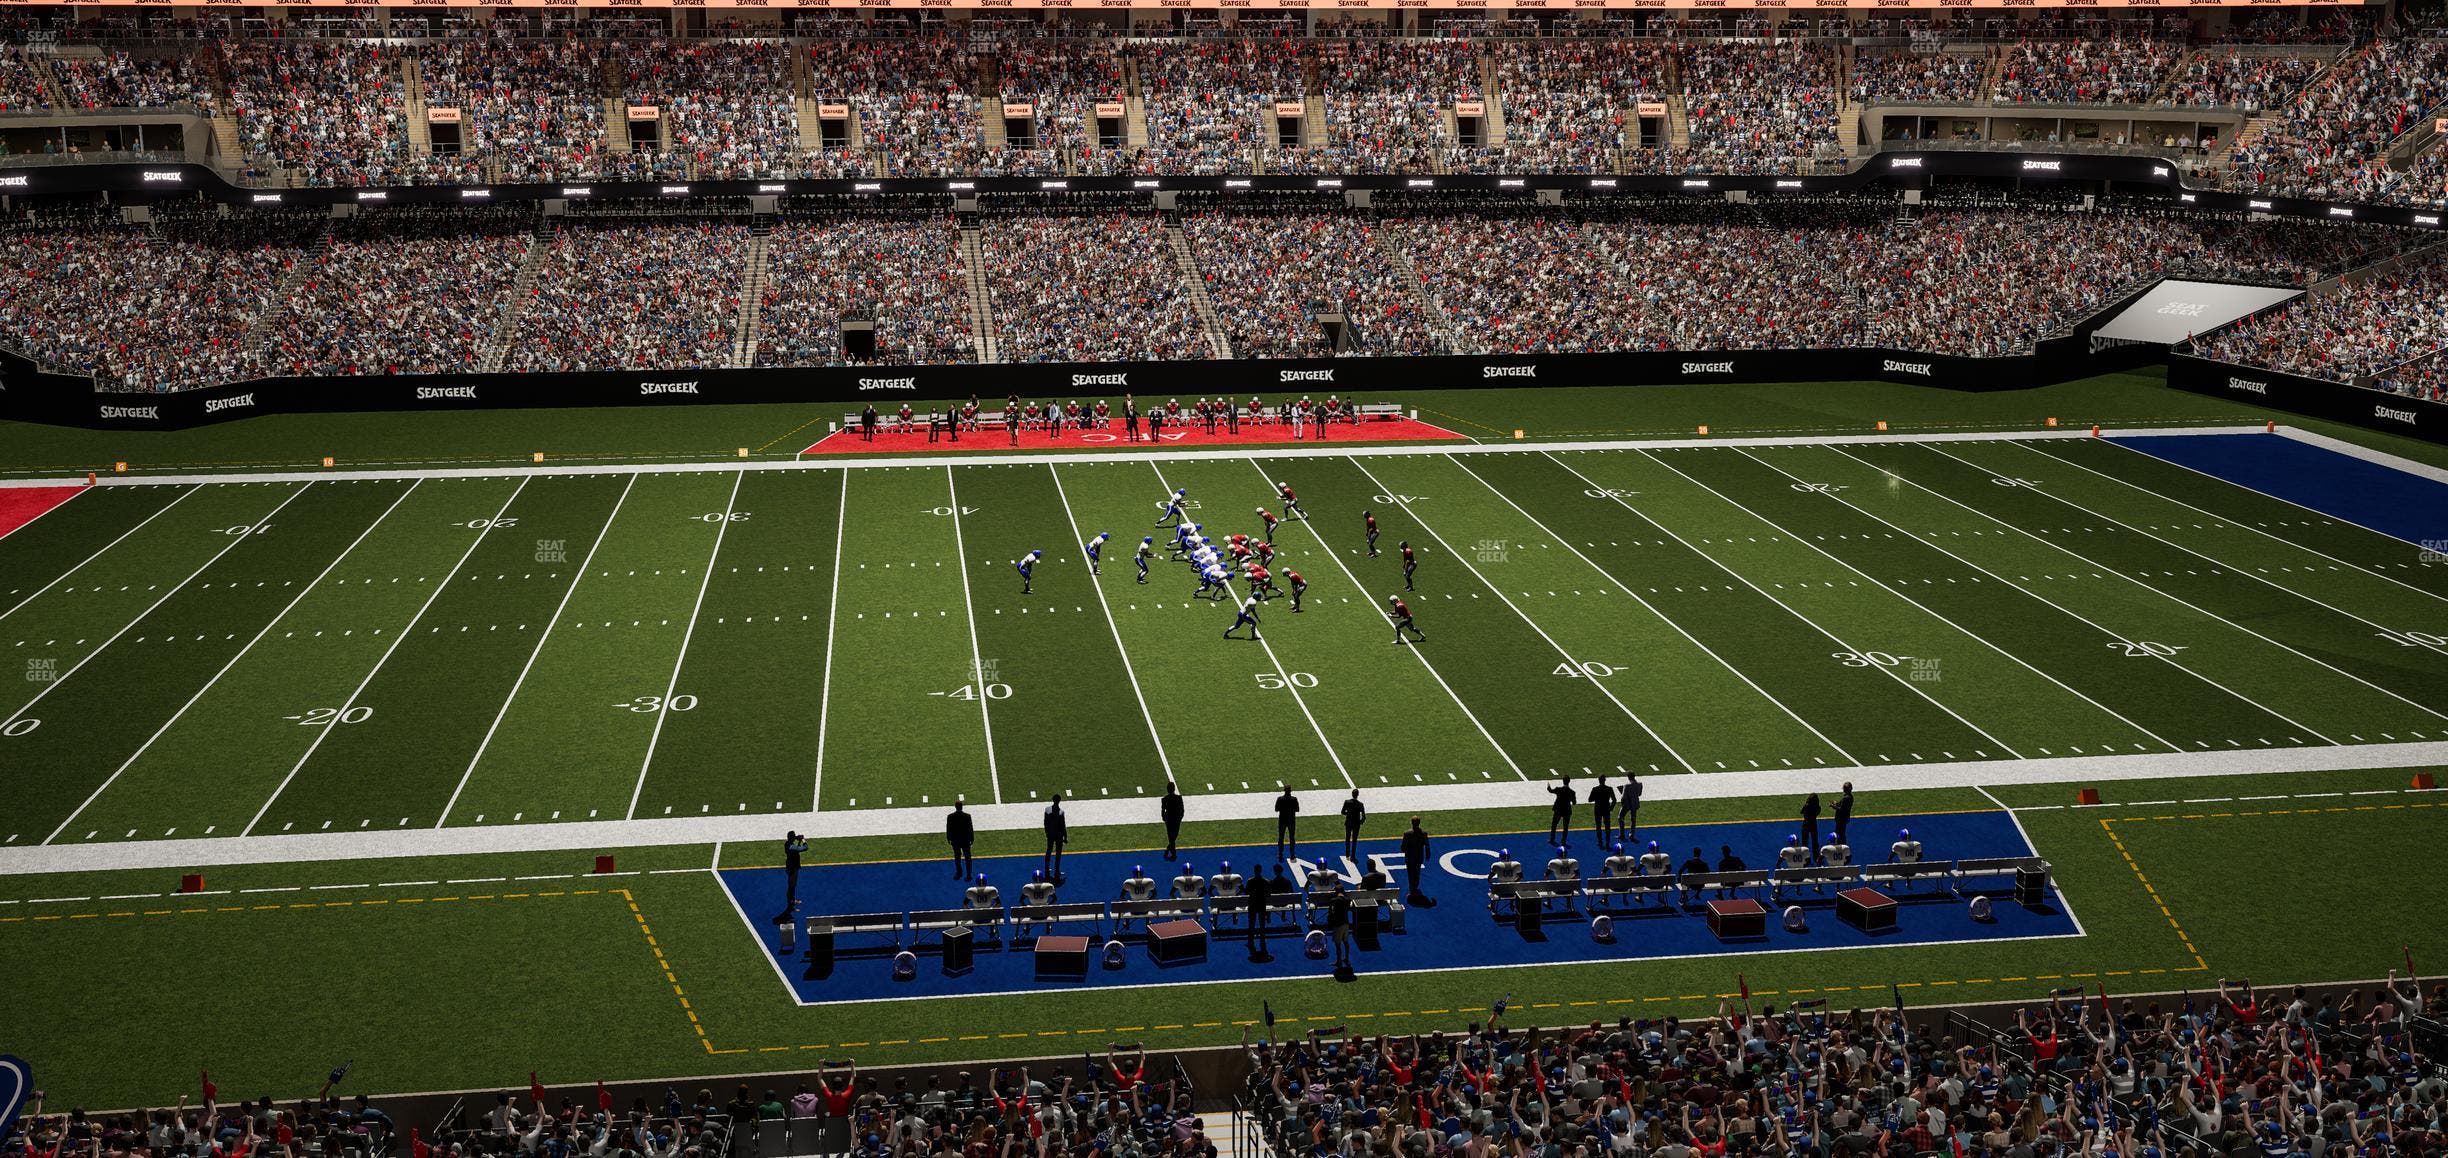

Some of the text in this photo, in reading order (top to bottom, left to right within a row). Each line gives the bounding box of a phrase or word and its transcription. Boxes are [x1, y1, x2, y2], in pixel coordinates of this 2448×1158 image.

[1891, 158, 1922, 168] SEATGEEK
[2022, 161, 2061, 171] SEATGEEK
[143, 172, 182, 182] SEATGEEK
[2414, 215, 2439, 225] SEATGEEK
[1483, 366, 1536, 377] SEATGEEK
[1681, 362, 1734, 373] SEATGEEK
[1883, 360, 1932, 376] SEATGEEK
[1072, 373, 1128, 386] SEATGEEK
[1280, 369, 1334, 381] SEATGEEK
[640, 382, 699, 394] SEATGEEK
[858, 377, 916, 390] SEATGEEK
[2228, 377, 2268, 394] SEATGEEK
[416, 386, 477, 398] SEATGEEK
[205, 393, 255, 412] SEATGEEK
[100, 406, 160, 419] SEATGEEK
[2374, 406, 2417, 424] SEATGEEK
[1254, 672, 1319, 689] 50
[1286, 848, 1500, 888] NFC
